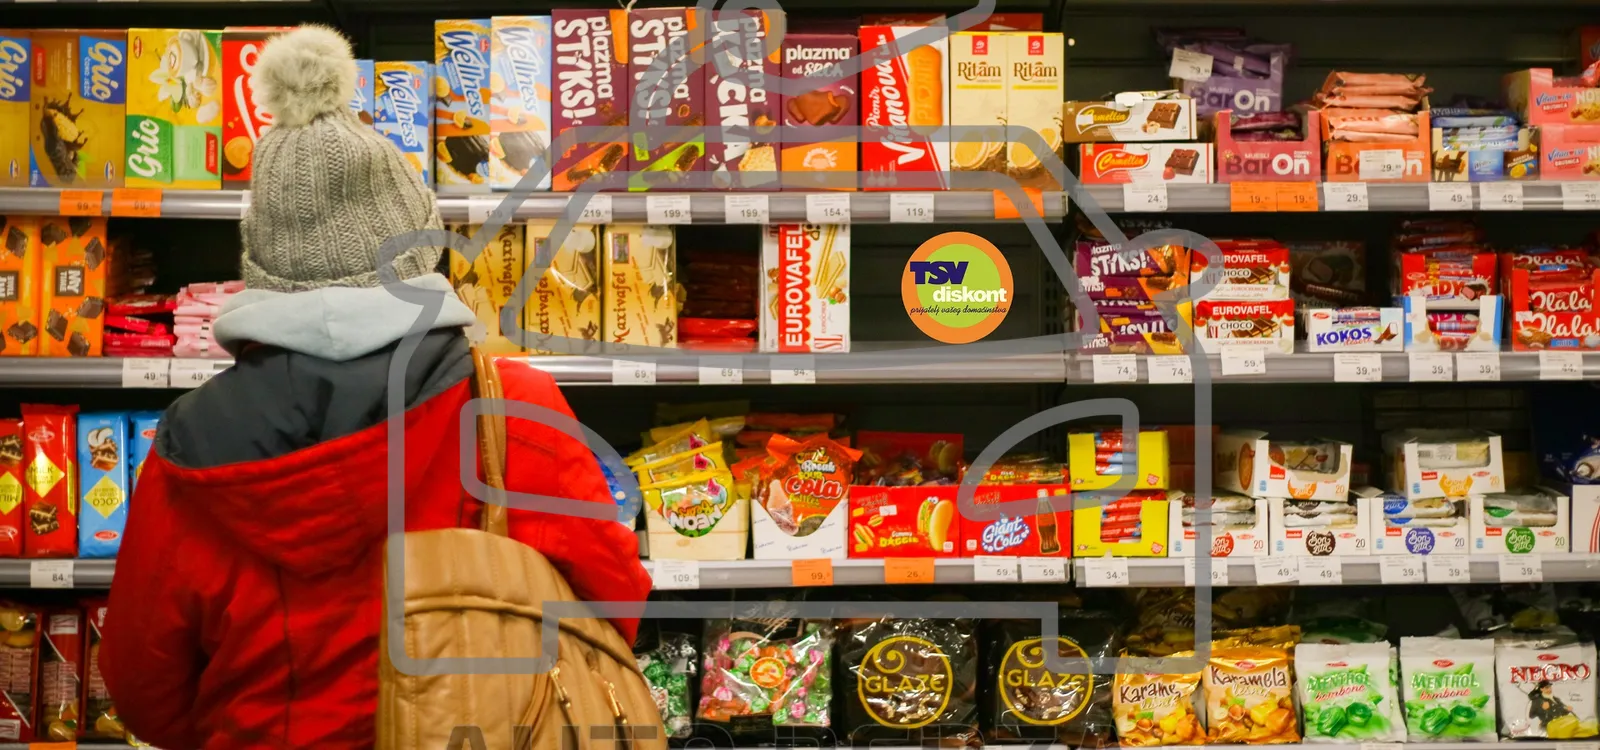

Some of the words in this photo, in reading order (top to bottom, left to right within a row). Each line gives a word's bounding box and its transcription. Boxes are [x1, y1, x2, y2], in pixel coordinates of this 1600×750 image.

[586, 15, 615, 100] plazma
[662, 16, 691, 100] plazma
[738, 15, 767, 103] plazma
[785, 45, 850, 64] plazma
[439, 29, 485, 118] Wellness
[496, 26, 541, 114] Wellness
[792, 65, 803, 75] od
[380, 69, 418, 148] Wellness
[865, 86, 884, 132] Pionir
[1193, 91, 1270, 112] BarOn
[873, 59, 926, 165] Vitanova
[1226, 153, 1311, 176] BarOn
[495, 222, 517, 298] Maxivafel
[1210, 254, 1269, 264] EUROVAFEL
[67, 269, 81, 295] MY
[1218, 269, 1250, 279] CHOCO
[784, 224, 804, 346] EUROVAFEL
[535, 276, 553, 354] Maxivafel
[612, 271, 633, 353] Maxivafel
[1212, 306, 1272, 316] EUROVAFEL
[1220, 322, 1253, 331] CHOCO
[1316, 327, 1372, 346] KOKOS
[1336, 485, 1345, 494] 20
[1489, 476, 1499, 485] 20
[92, 497, 119, 506] COCO
[982, 515, 1023, 543] Giant
[993, 533, 1023, 551] Cola
[1254, 539, 1264, 549] 20
[1355, 538, 1366, 548] 20
[1454, 538, 1465, 547] 20
[1554, 537, 1565, 546] 20
[865, 674, 945, 693] GLAZE
[1006, 669, 1086, 693] GLAZE
[1211, 666, 1288, 688] Karamela
[1306, 672, 1373, 692] MENTHOL
[1411, 673, 1480, 690] MENTHOL
[1510, 663, 1592, 685] NEGRO
[1315, 684, 1366, 702] bombone
[1420, 688, 1471, 701] bombone
